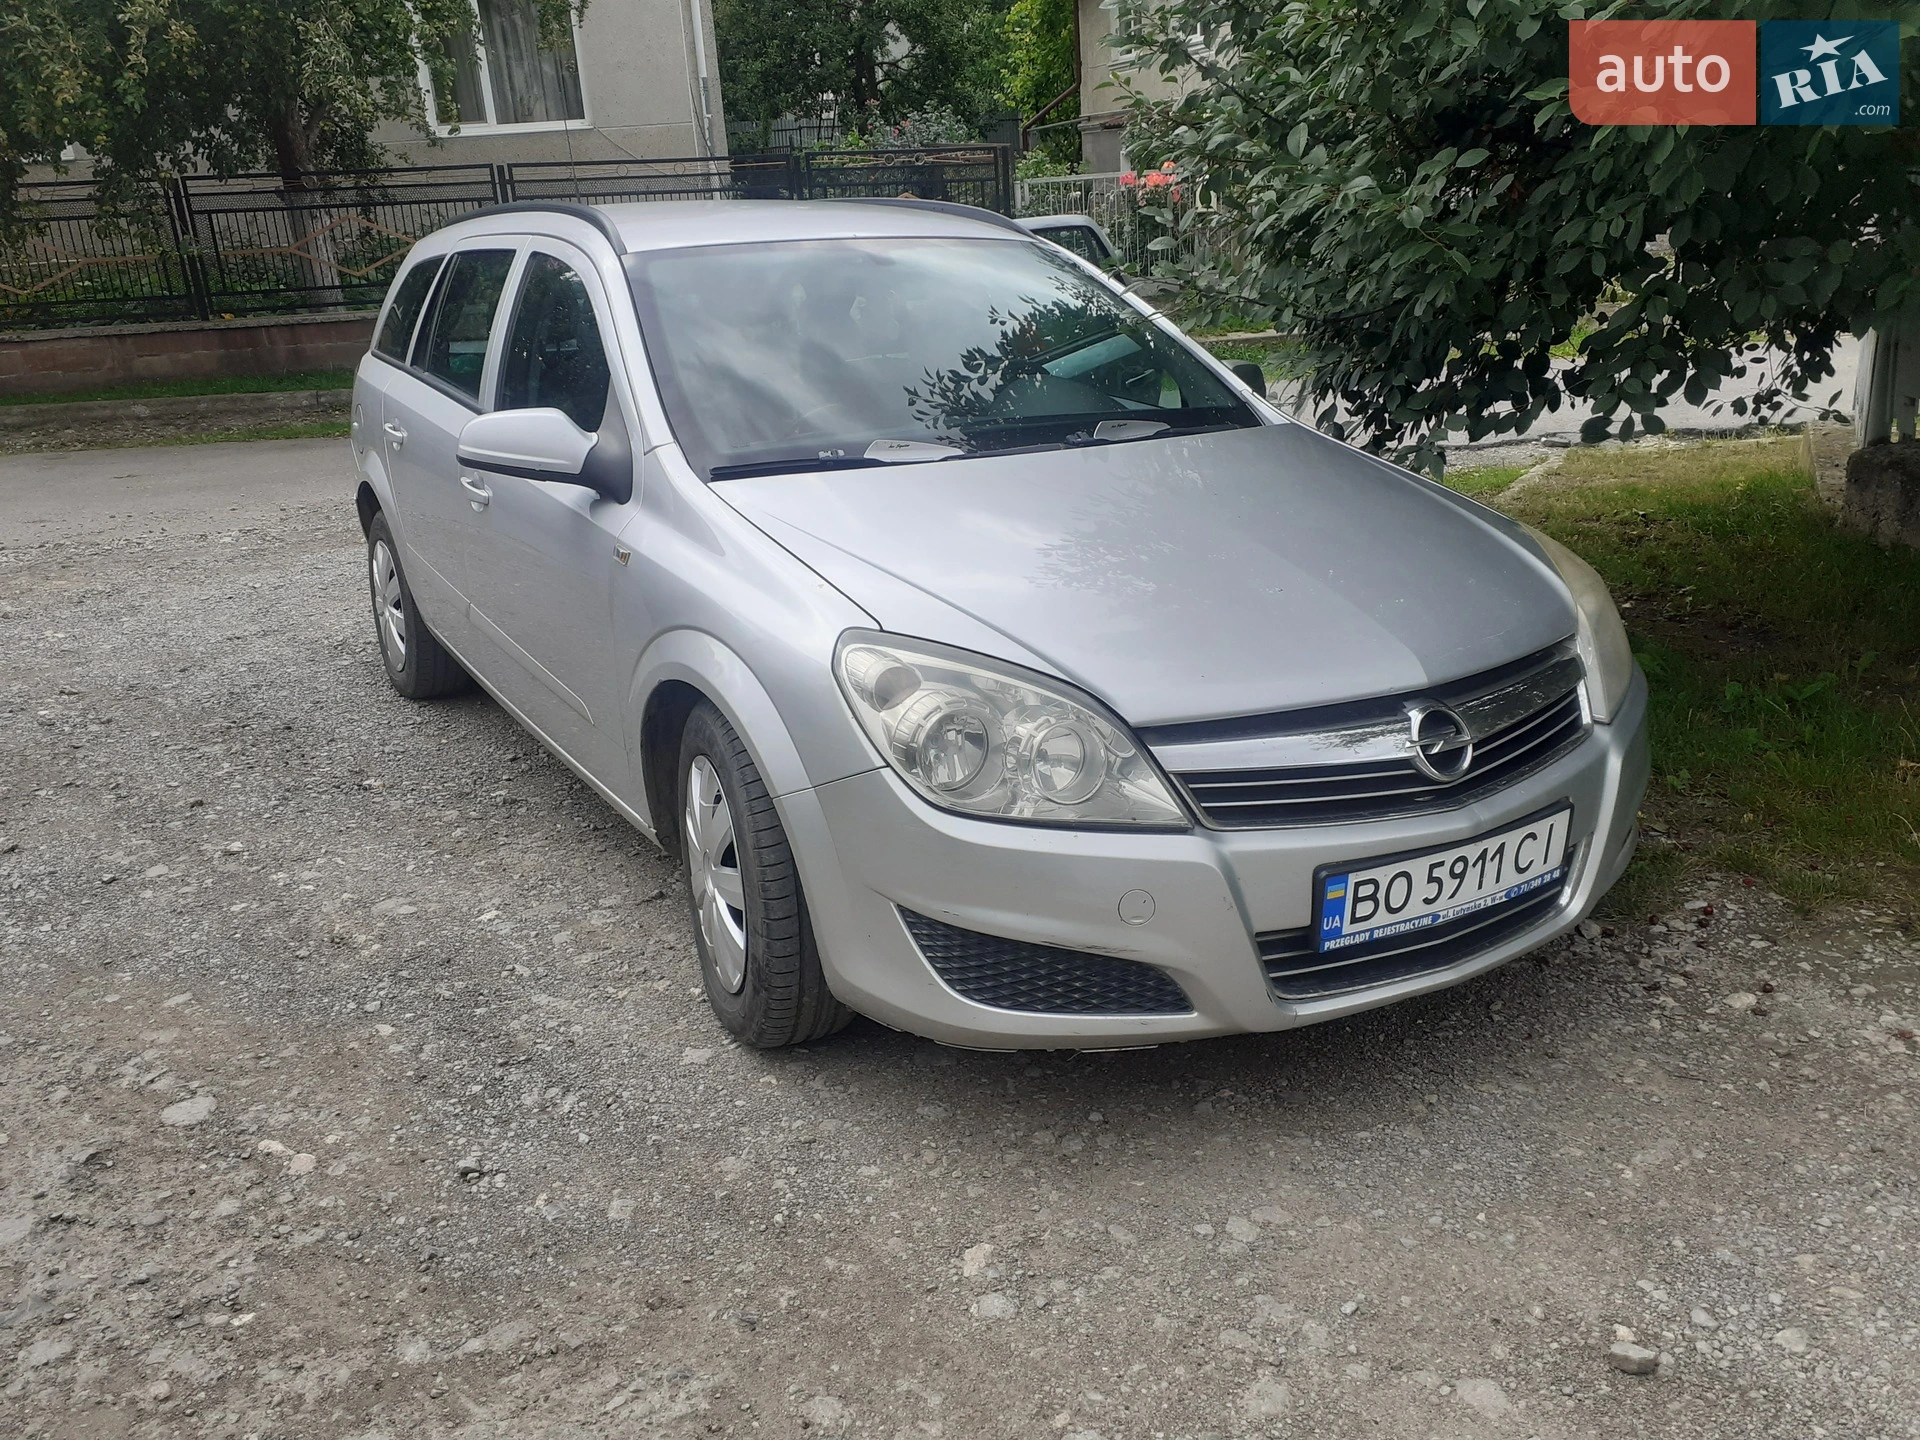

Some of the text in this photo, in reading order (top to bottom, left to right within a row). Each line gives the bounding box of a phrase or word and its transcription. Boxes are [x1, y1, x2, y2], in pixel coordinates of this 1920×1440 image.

[1350, 822, 1554, 925] BO 5911 CI
[1323, 915, 1341, 930] UA
[1324, 931, 1371, 951] PRZEGLĄDY
[1373, 915, 1433, 938] REJESTRACYJNE
[1442, 910, 1451, 920] ul.
[1452, 902, 1481, 916] Lutyńska
[1519, 877, 1542, 894] 71/349
